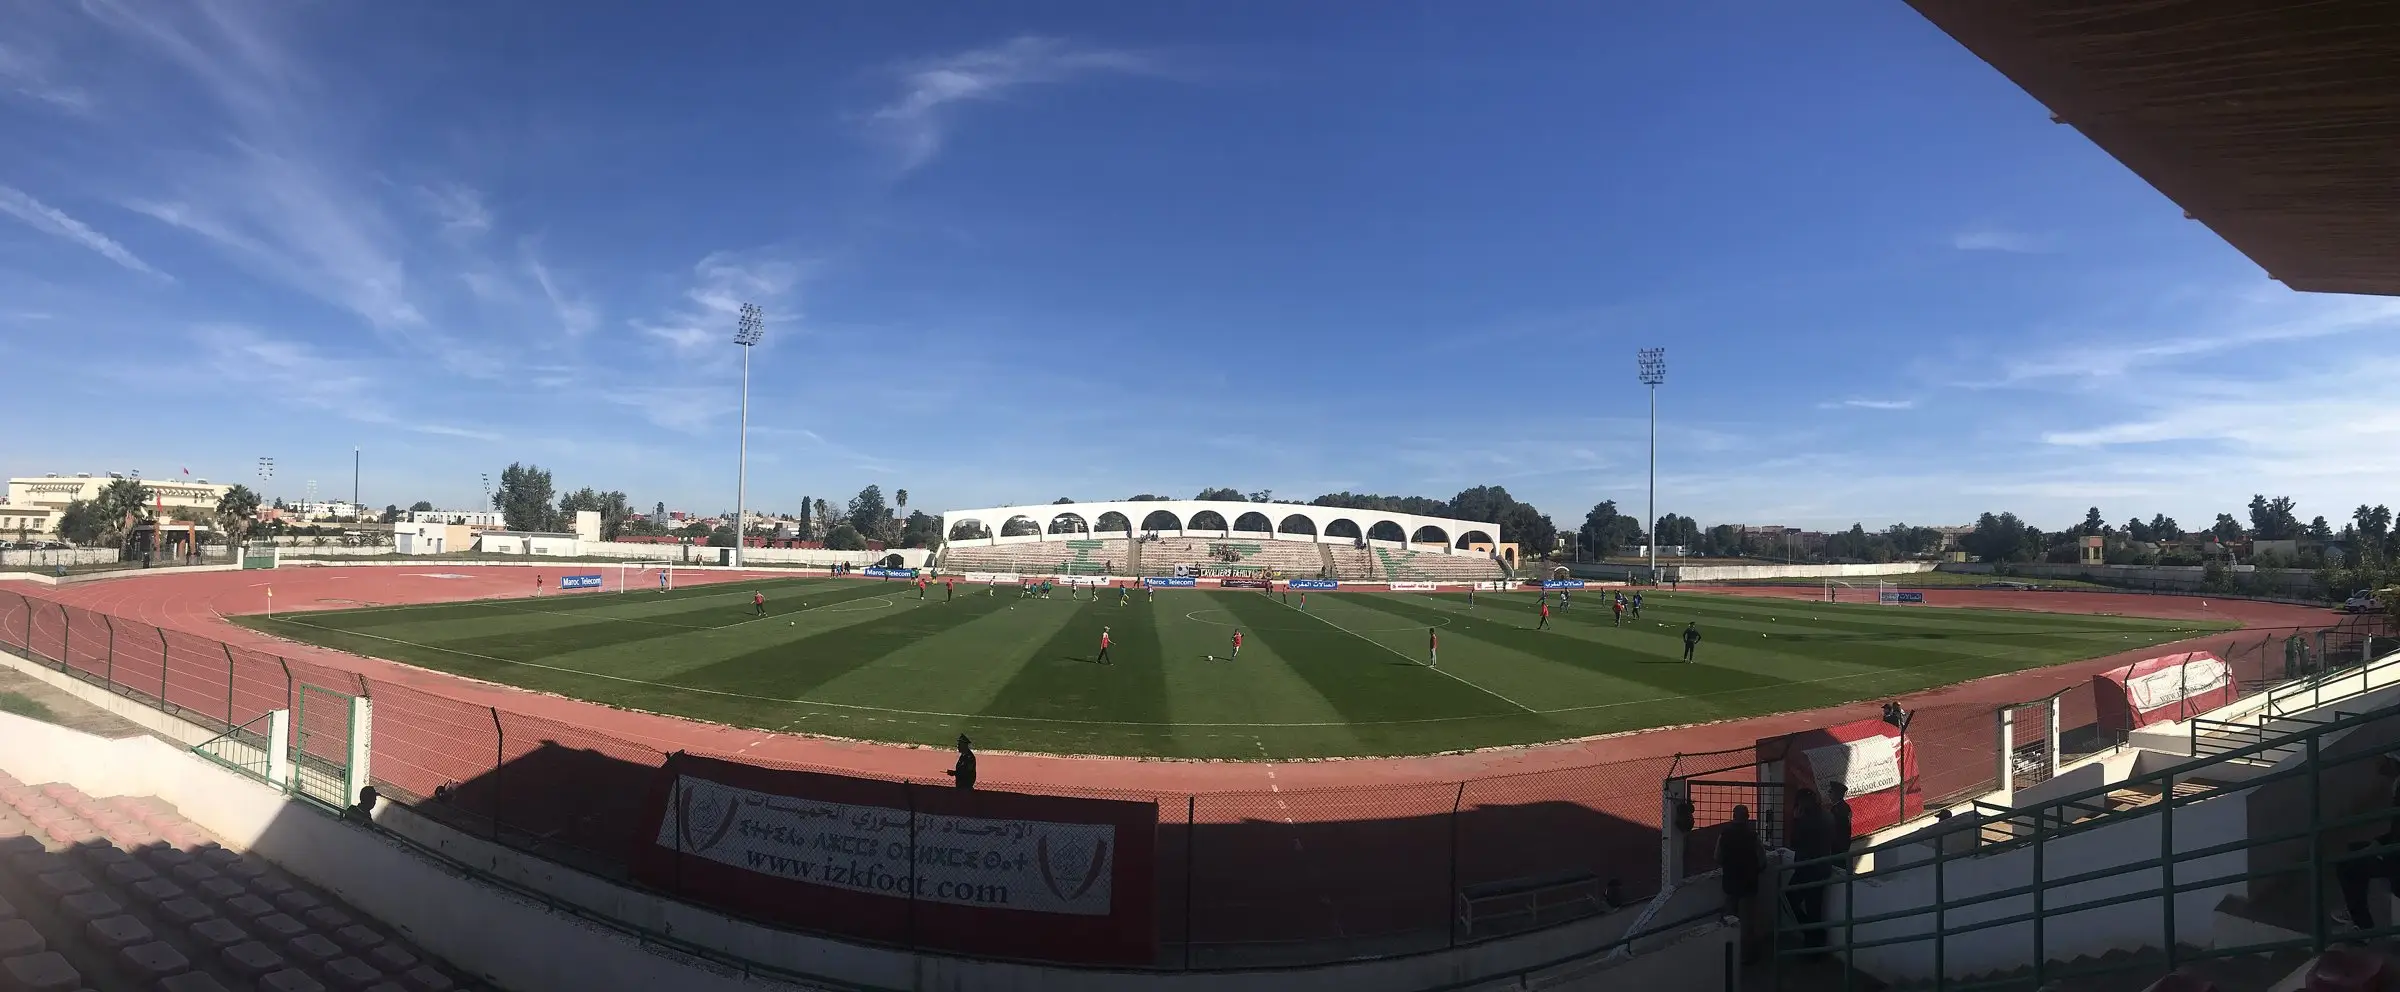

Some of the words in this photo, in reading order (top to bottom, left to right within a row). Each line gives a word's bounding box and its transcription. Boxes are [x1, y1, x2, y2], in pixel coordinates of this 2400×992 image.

[1232, 568, 1252, 577] FAMILY
[563, 577, 580, 586] Maroc
[581, 576, 601, 585] Telecom
[747, 850, 1008, 903] www.izkfoot.com
